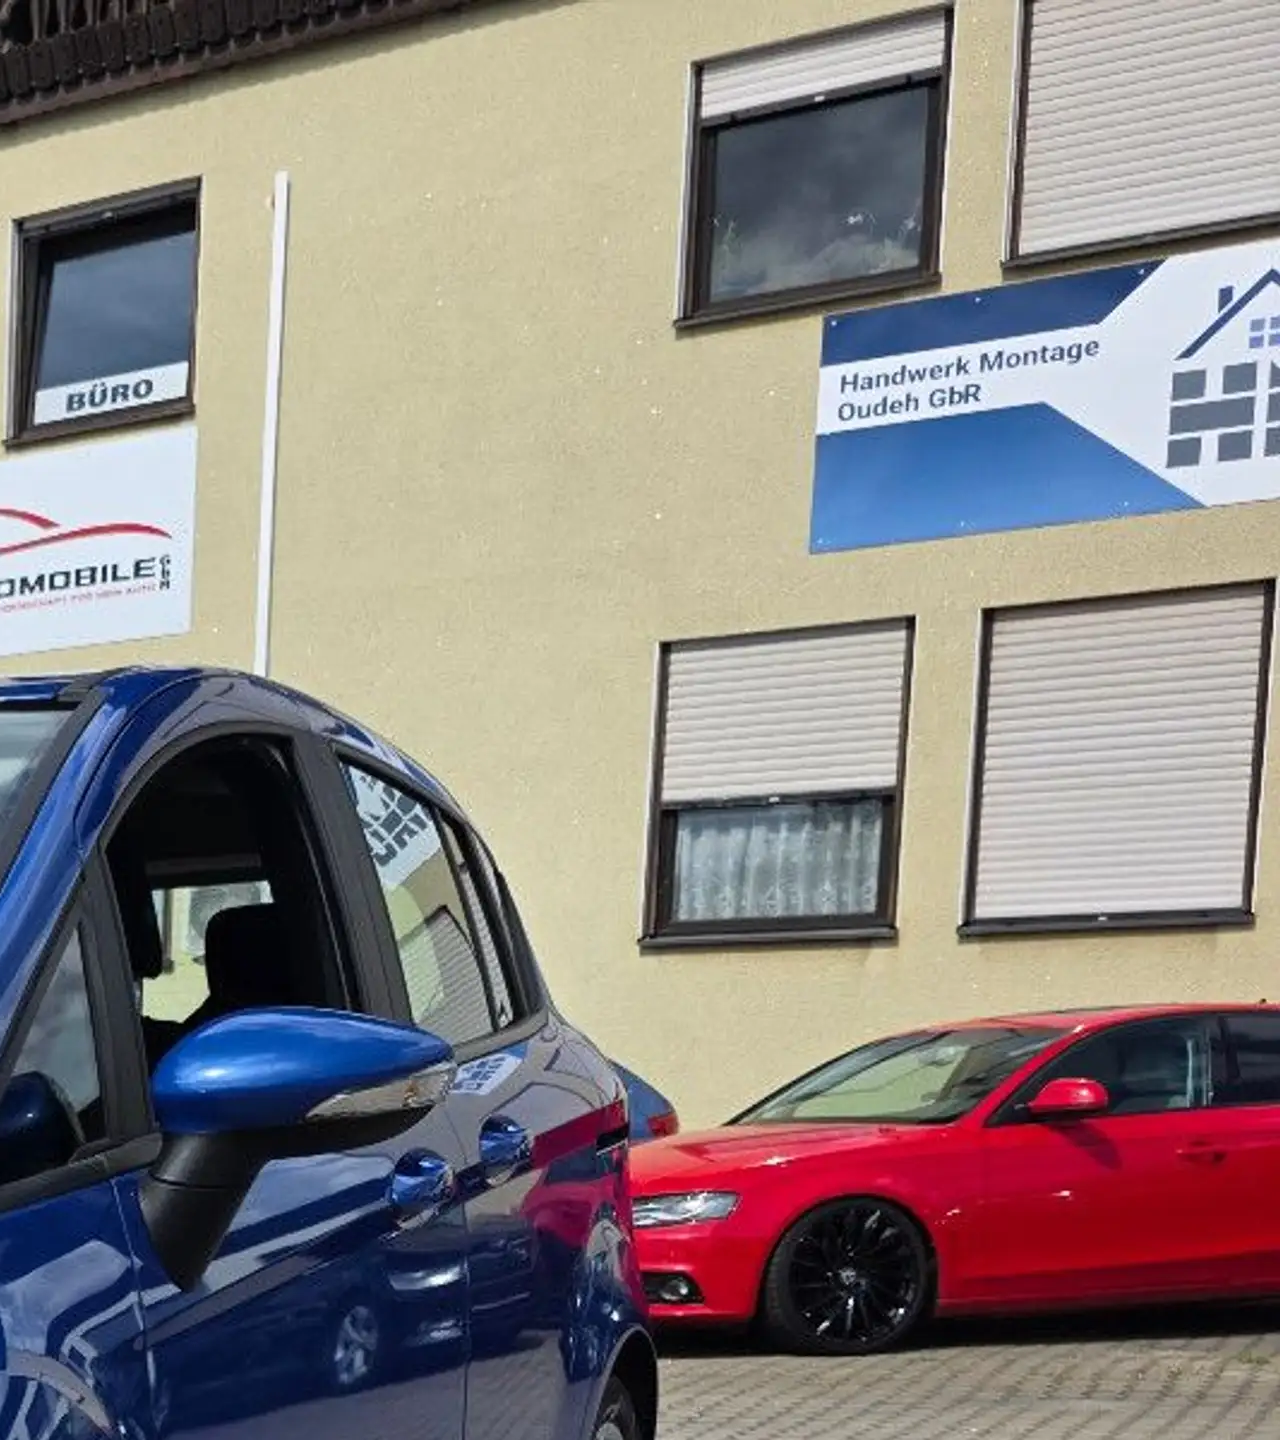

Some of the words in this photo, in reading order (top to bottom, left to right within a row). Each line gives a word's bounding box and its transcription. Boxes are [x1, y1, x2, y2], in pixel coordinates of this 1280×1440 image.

[839, 356, 971, 395] Handwerk
[979, 337, 1100, 373] Montage
[65, 378, 154, 413] BÜRO
[837, 394, 920, 422] Oudeh
[928, 383, 981, 408] GbR
